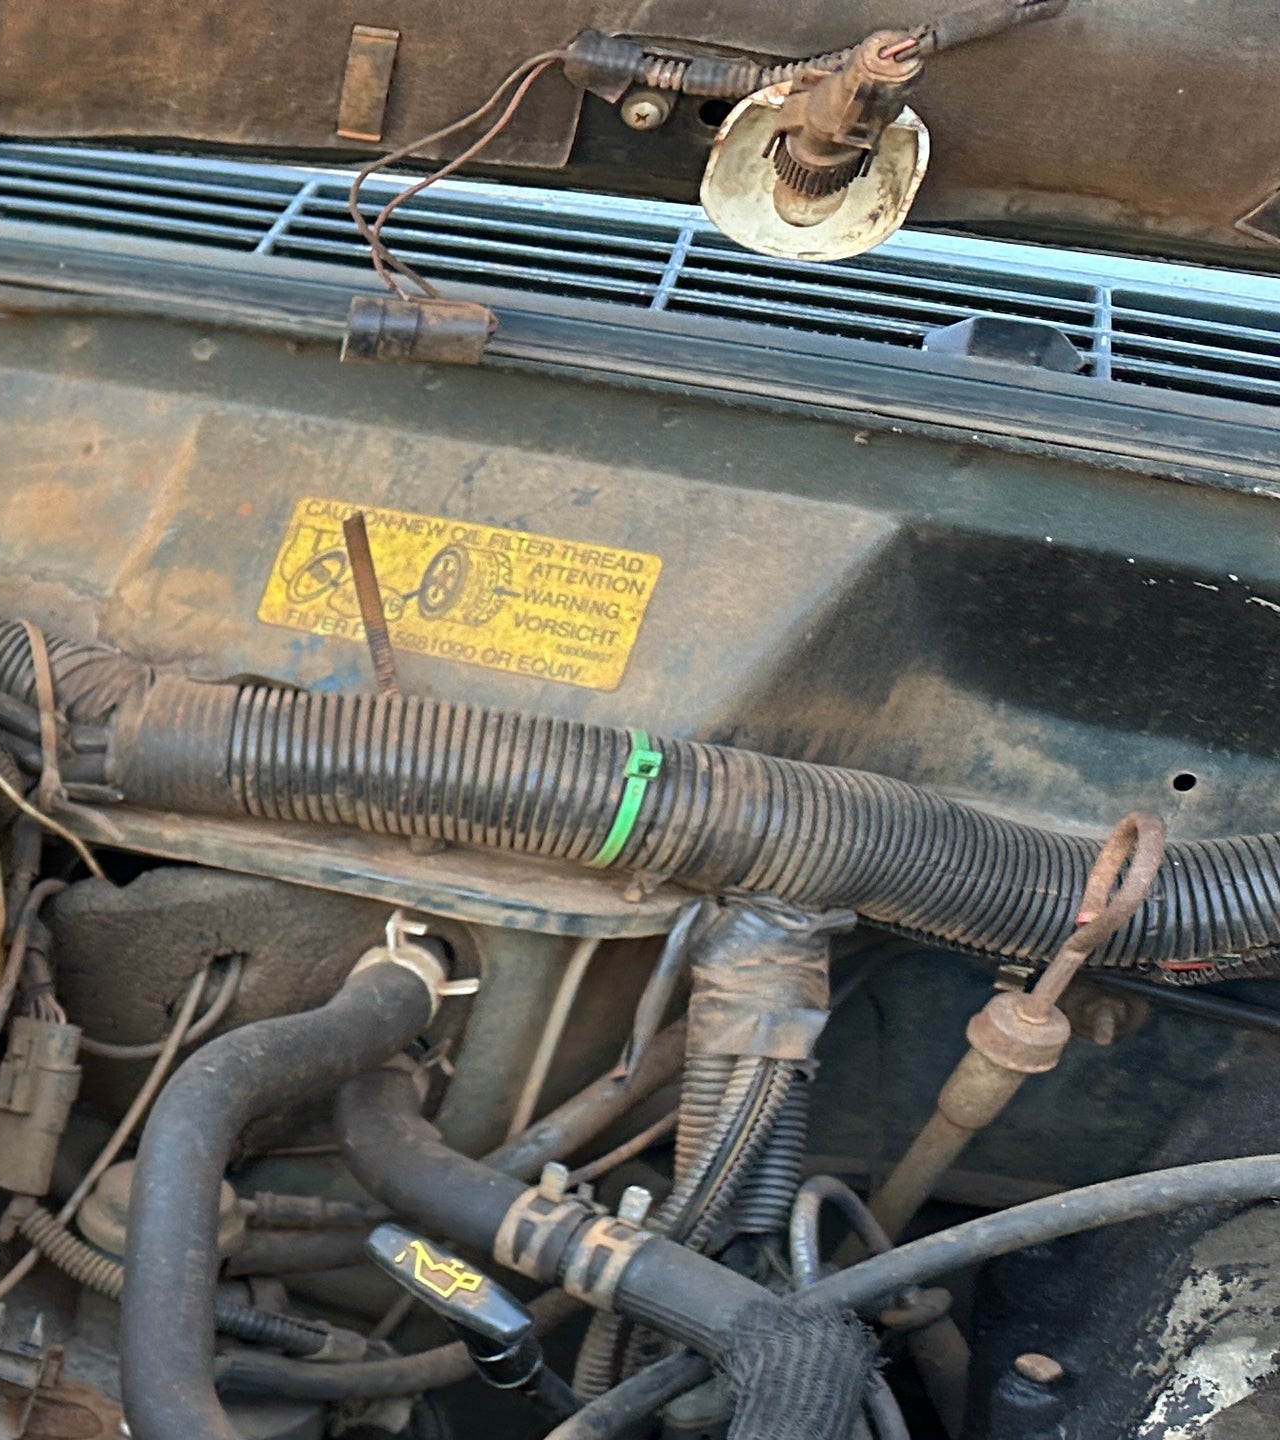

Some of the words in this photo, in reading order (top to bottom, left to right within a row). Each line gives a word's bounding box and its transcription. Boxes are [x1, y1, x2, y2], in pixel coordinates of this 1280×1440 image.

[306, 501, 446, 537] CAUON-NEW
[450, 526, 482, 545] OIL
[490, 533, 554, 558] FILTER
[561, 545, 643, 573] THREAD
[530, 562, 646, 595] ATTENTION
[524, 587, 621, 619] WARNING
[287, 612, 347, 634] FILTER
[481, 647, 512, 668] OR
[514, 613, 620, 646] VORSICHT
